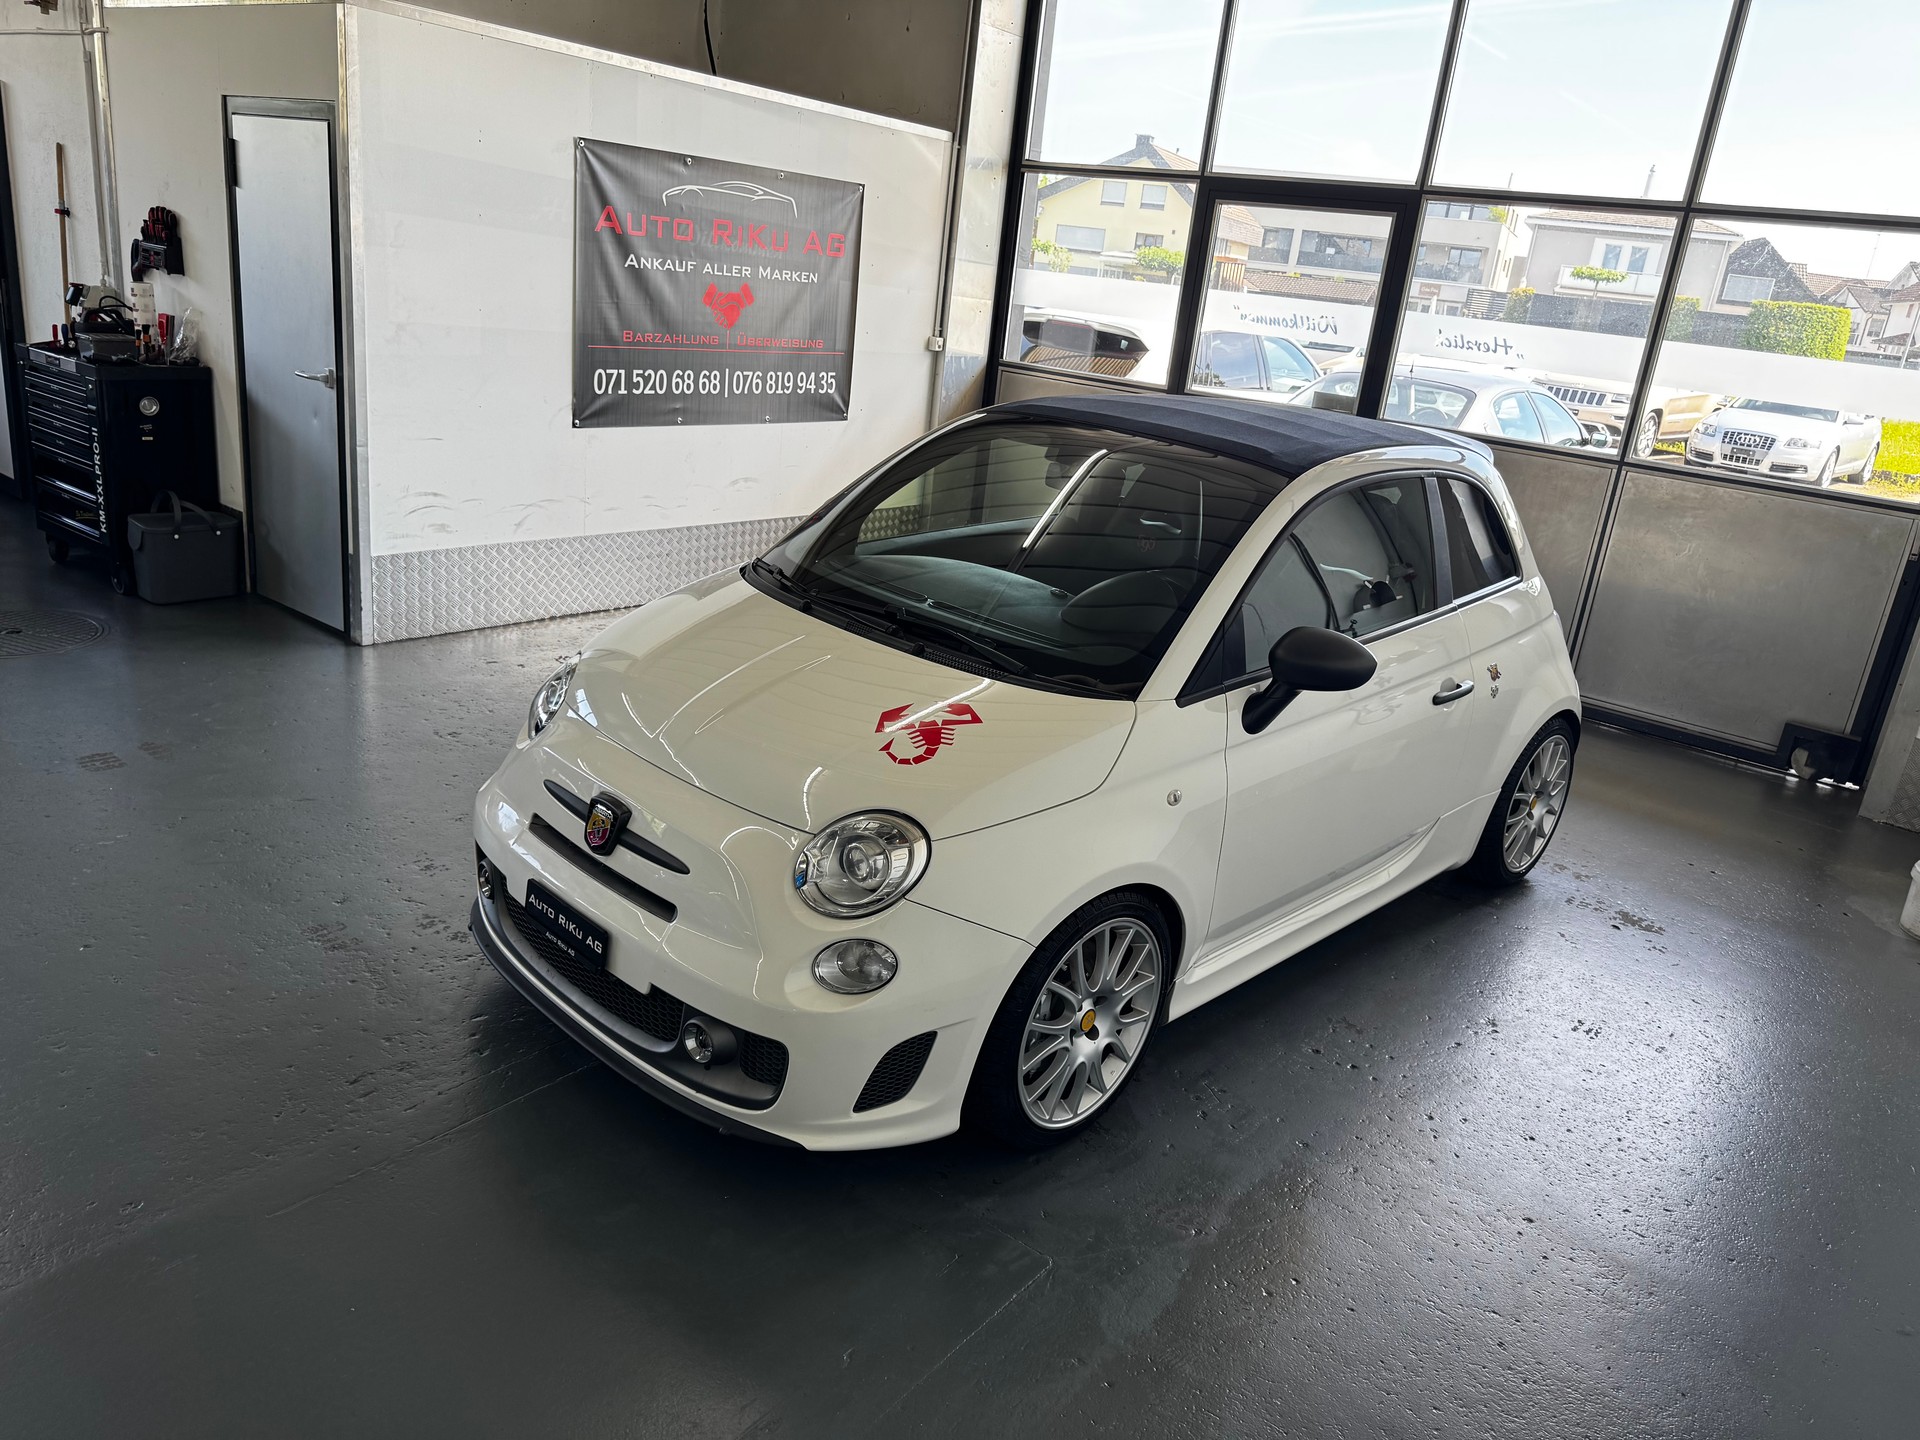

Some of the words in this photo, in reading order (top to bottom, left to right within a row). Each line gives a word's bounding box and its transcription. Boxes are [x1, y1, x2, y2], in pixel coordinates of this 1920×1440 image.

[594, 205, 694, 241] AUTO
[802, 230, 846, 258] AG
[624, 253, 697, 273] ANKAUF
[702, 261, 751, 278] ALLER
[758, 265, 818, 284] MARKEN
[622, 330, 720, 345] BARZAHLUNG
[736, 331, 825, 349] ÜBERWEISUNG
[593, 368, 628, 395] 071
[632, 369, 667, 395] 520
[671, 370, 694, 395] 68
[698, 370, 721, 395] 68
[732, 370, 763, 395] 076
[766, 371, 793, 395] 819
[796, 371, 816, 394] 94
[818, 371, 837, 394] 35
[528, 893, 555, 919] AUTO
[585, 935, 603, 955] AG
